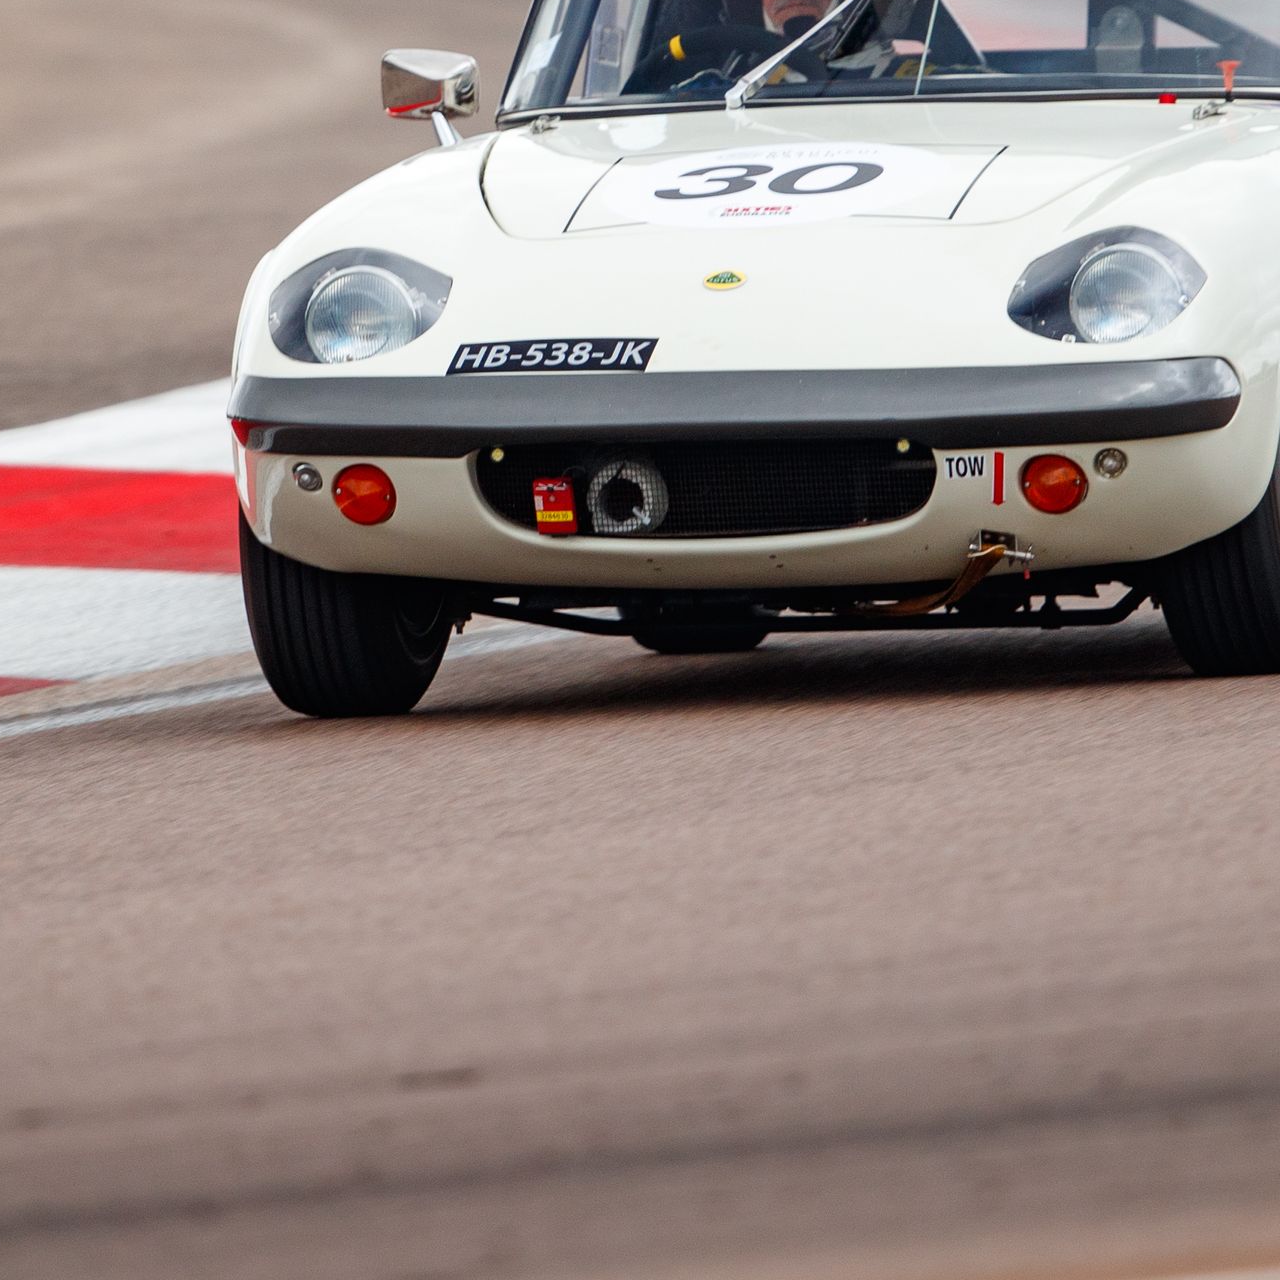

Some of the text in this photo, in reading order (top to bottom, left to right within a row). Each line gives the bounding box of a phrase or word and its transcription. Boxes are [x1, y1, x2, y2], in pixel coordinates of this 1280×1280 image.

[654, 162, 884, 199] 30
[455, 340, 651, 369] HB-538-JK
[945, 455, 985, 479] TOW
